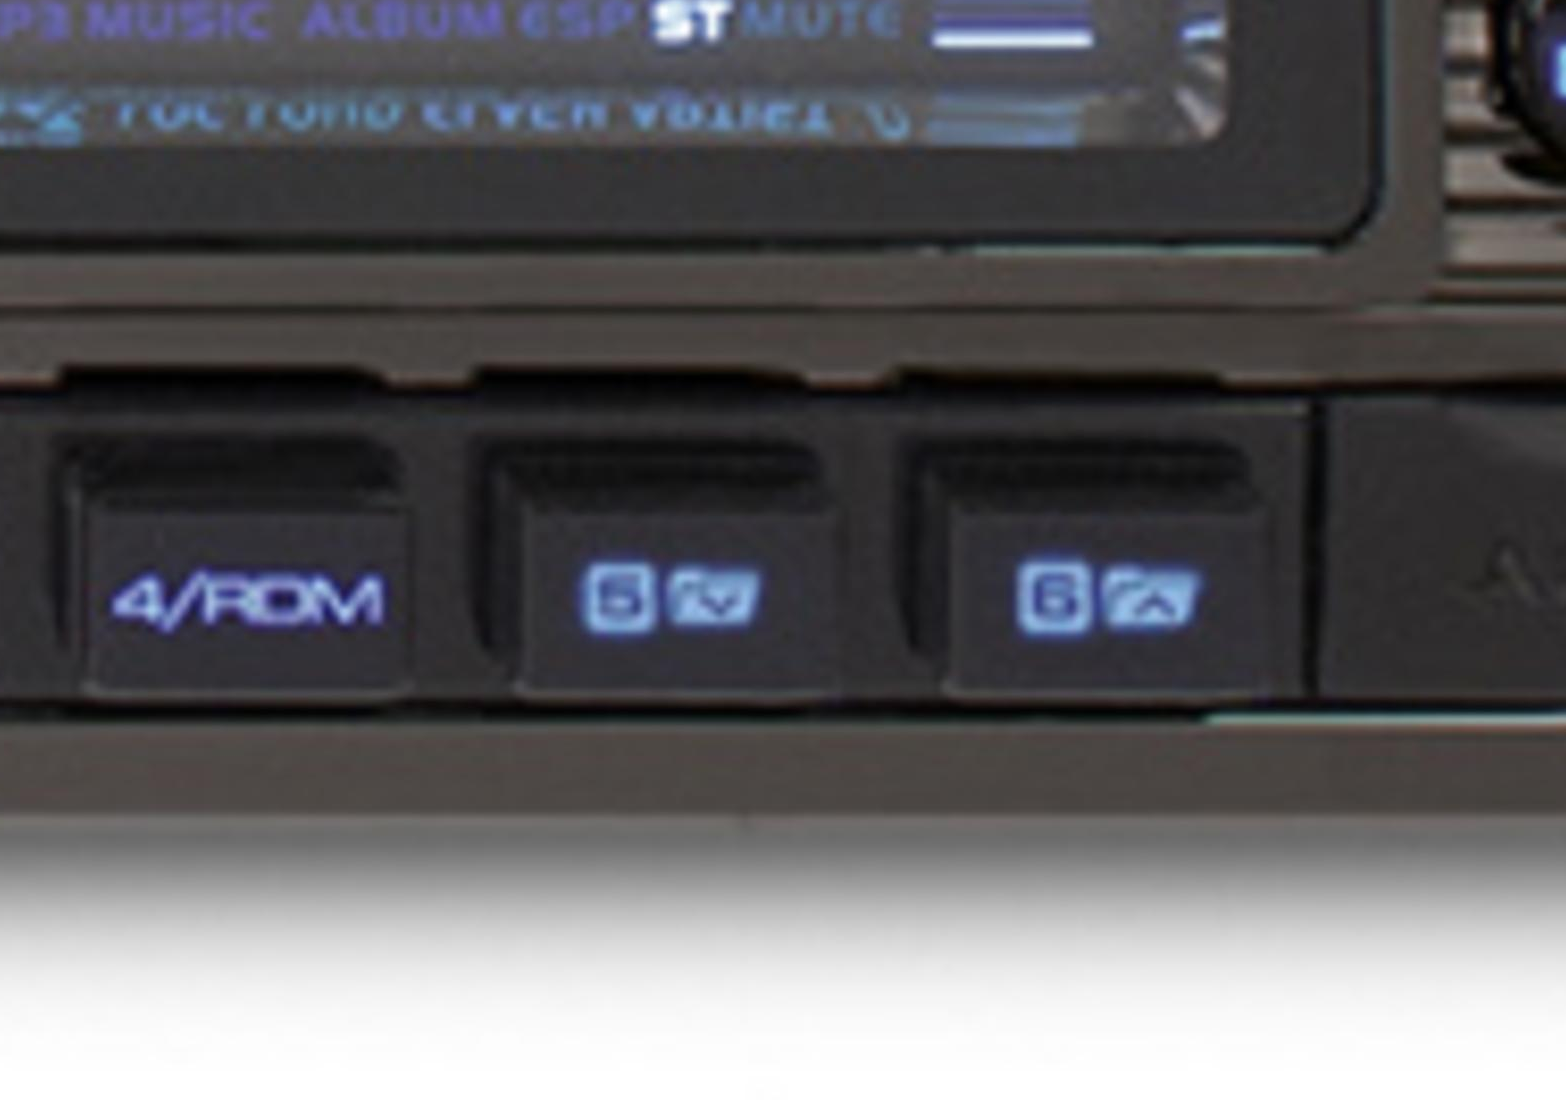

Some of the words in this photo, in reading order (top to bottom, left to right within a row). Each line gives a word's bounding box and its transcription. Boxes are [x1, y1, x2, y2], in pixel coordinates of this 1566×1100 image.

[87, 2, 270, 40] MUSIC
[303, 2, 502, 40] ALBUM
[743, 2, 902, 40] MUTE
